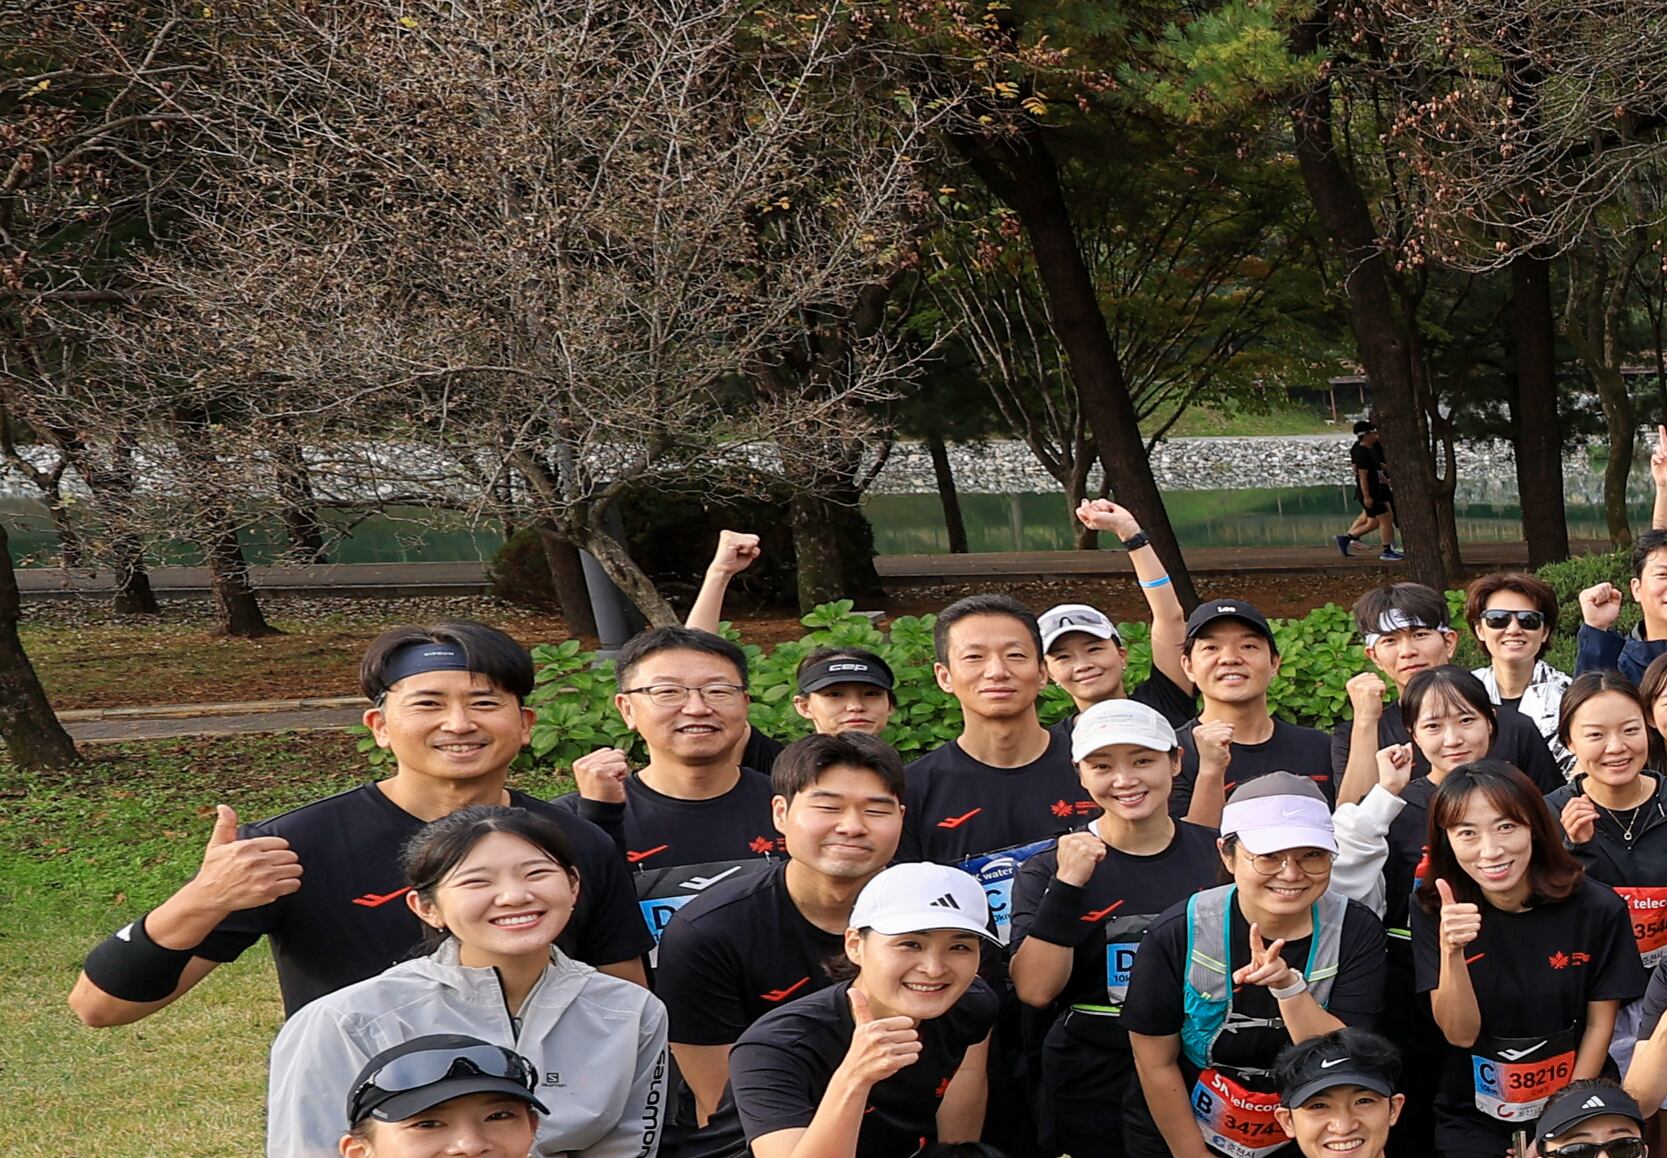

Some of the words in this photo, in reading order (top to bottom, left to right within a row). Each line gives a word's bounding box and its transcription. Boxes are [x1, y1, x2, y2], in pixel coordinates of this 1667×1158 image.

[982, 867, 1013, 881] water
[986, 890, 1006, 911] C
[1116, 950, 1135, 972] D
[1480, 1063, 1497, 1085] C
[1508, 1062, 1568, 1090] 38216
[1197, 1090, 1213, 1114] B
[1224, 1114, 1281, 1137] 3474
